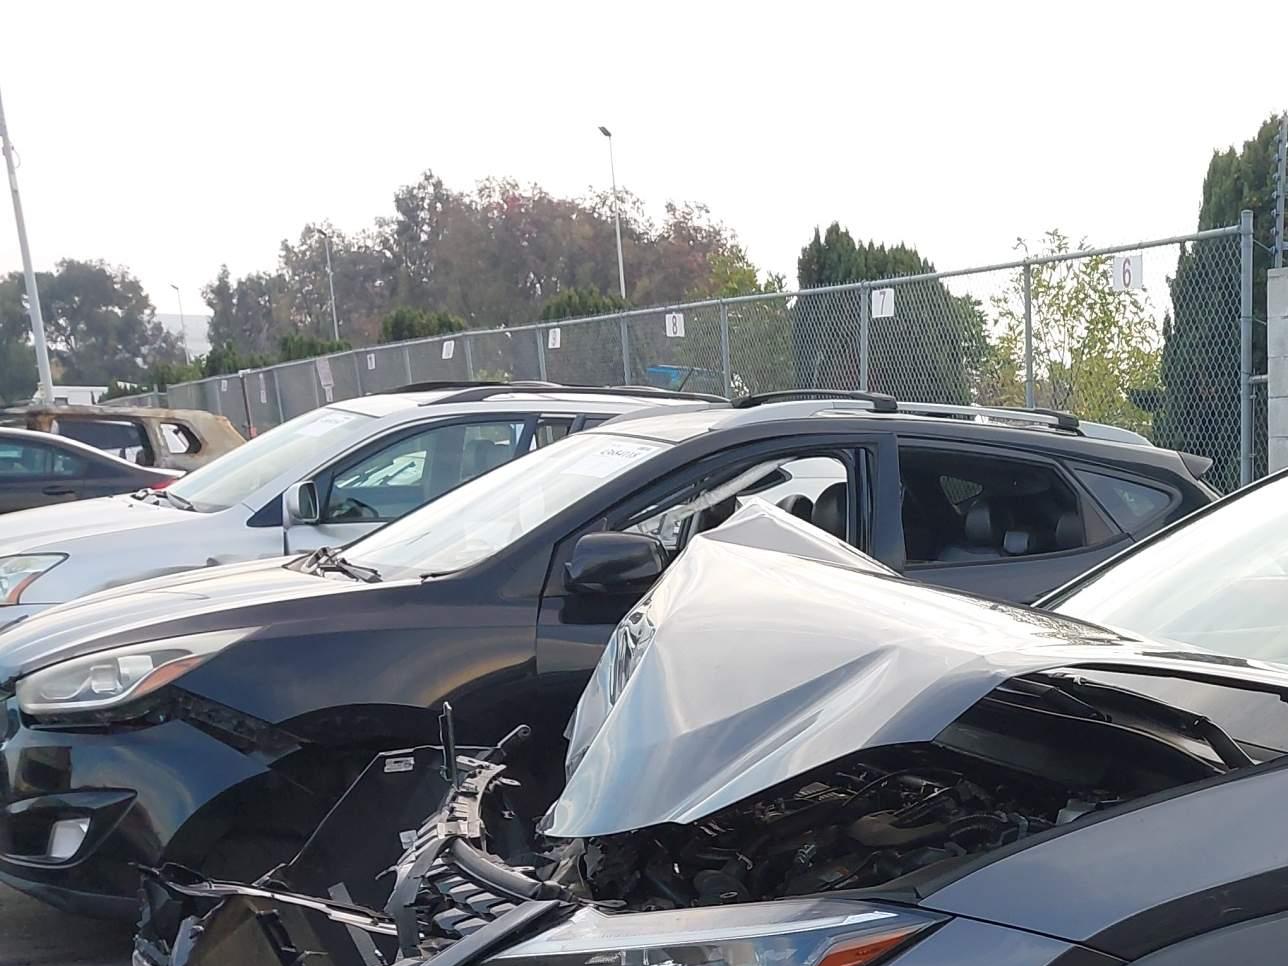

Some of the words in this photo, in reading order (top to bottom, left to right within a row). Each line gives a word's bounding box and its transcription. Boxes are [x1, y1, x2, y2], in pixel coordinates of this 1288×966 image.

[1123, 257, 1131, 288] 6
[880, 291, 886, 315] 7
[672, 315, 678, 335] 8
